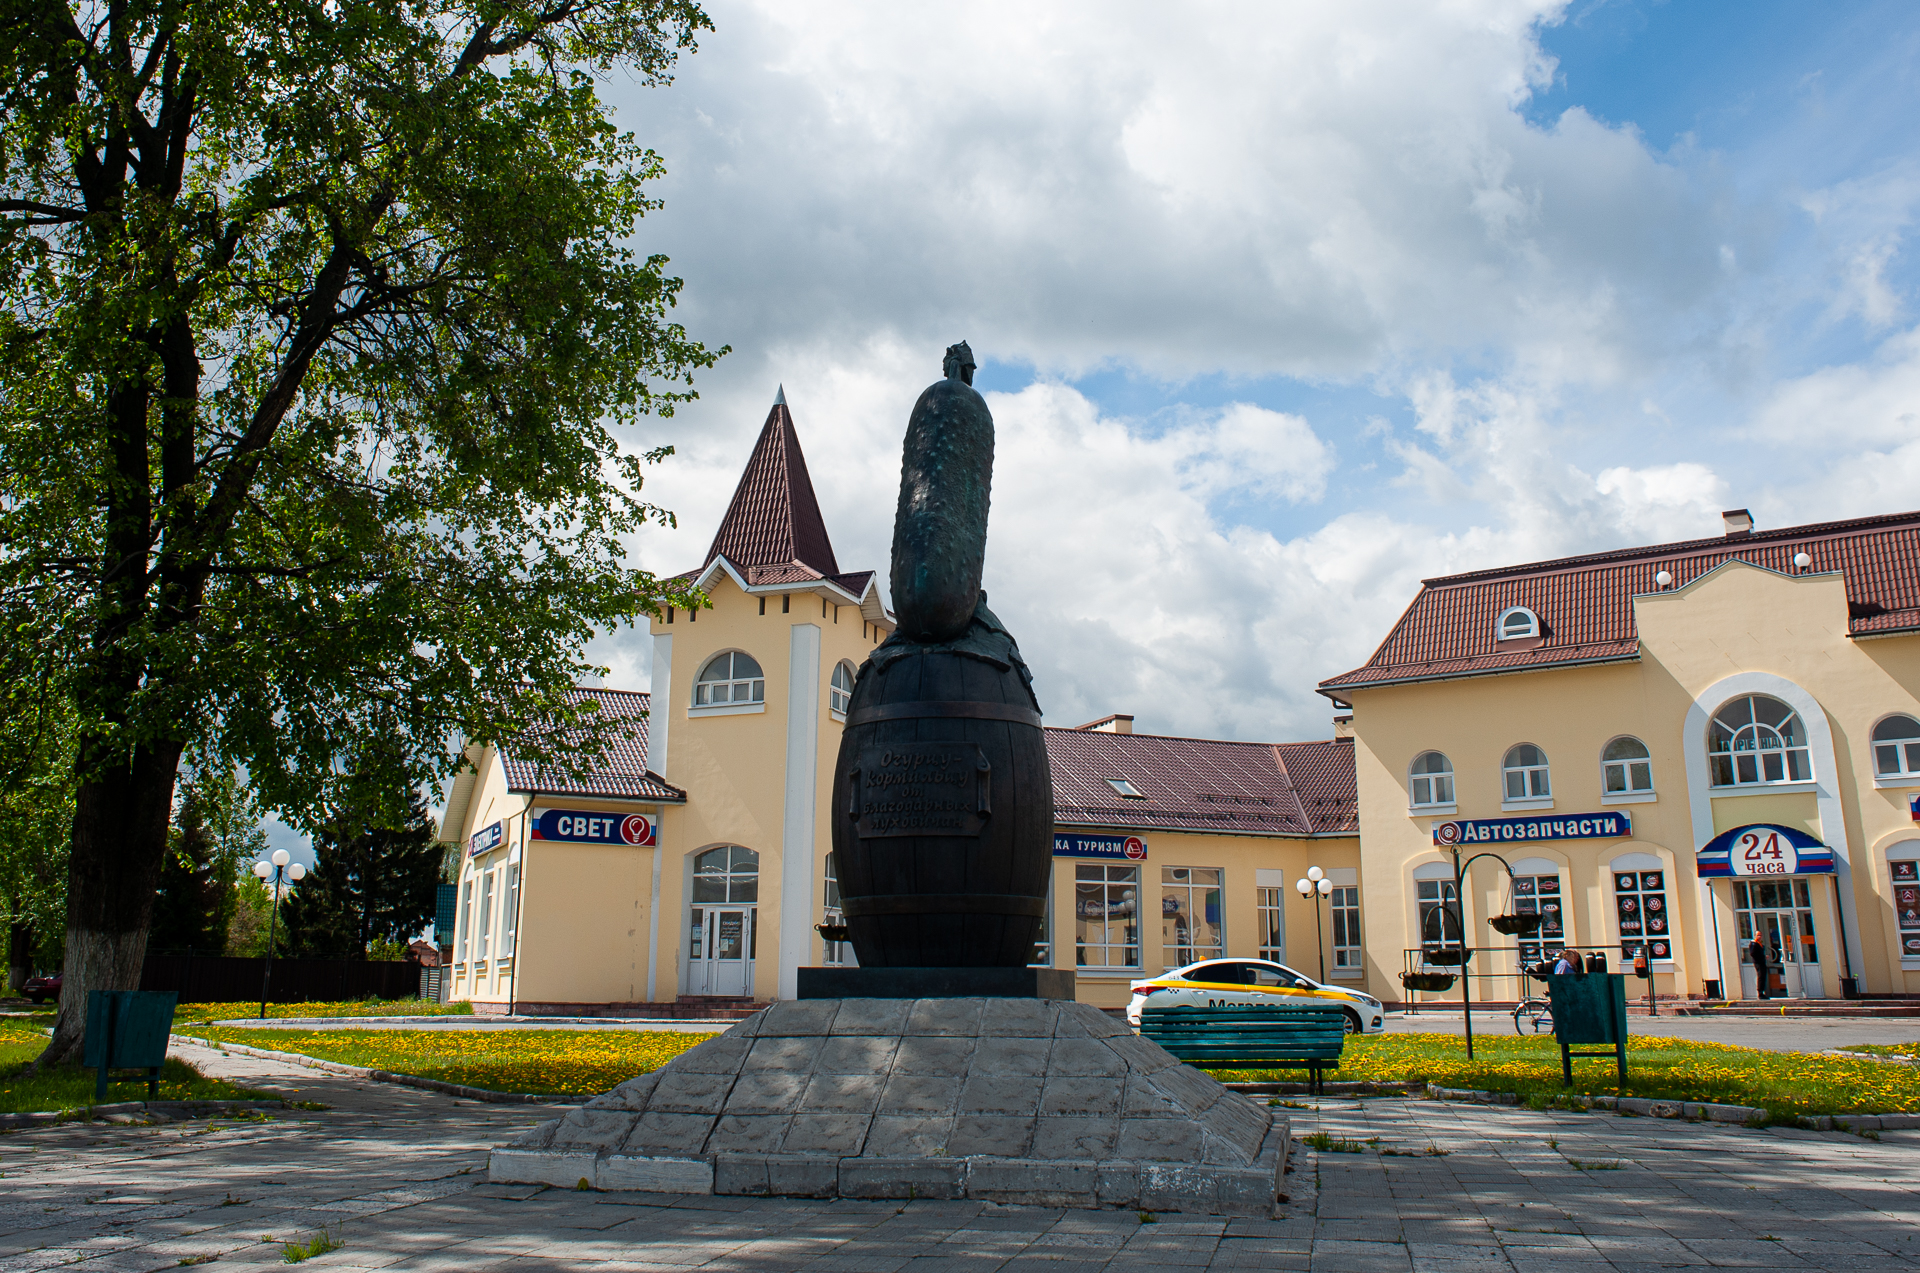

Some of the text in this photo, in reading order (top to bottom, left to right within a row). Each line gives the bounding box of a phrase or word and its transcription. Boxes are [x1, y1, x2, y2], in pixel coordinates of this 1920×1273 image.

[881, 749, 962, 770] Огурцу-
[901, 787, 925, 798] от
[863, 799, 972, 817] благодарных
[557, 816, 614, 838] СВЕТ
[1463, 817, 1617, 842] Автозапчасти
[1053, 839, 1122, 853] КА ТУРИЗМ
[1741, 832, 1783, 861] 24
[1745, 861, 1786, 875] часа
